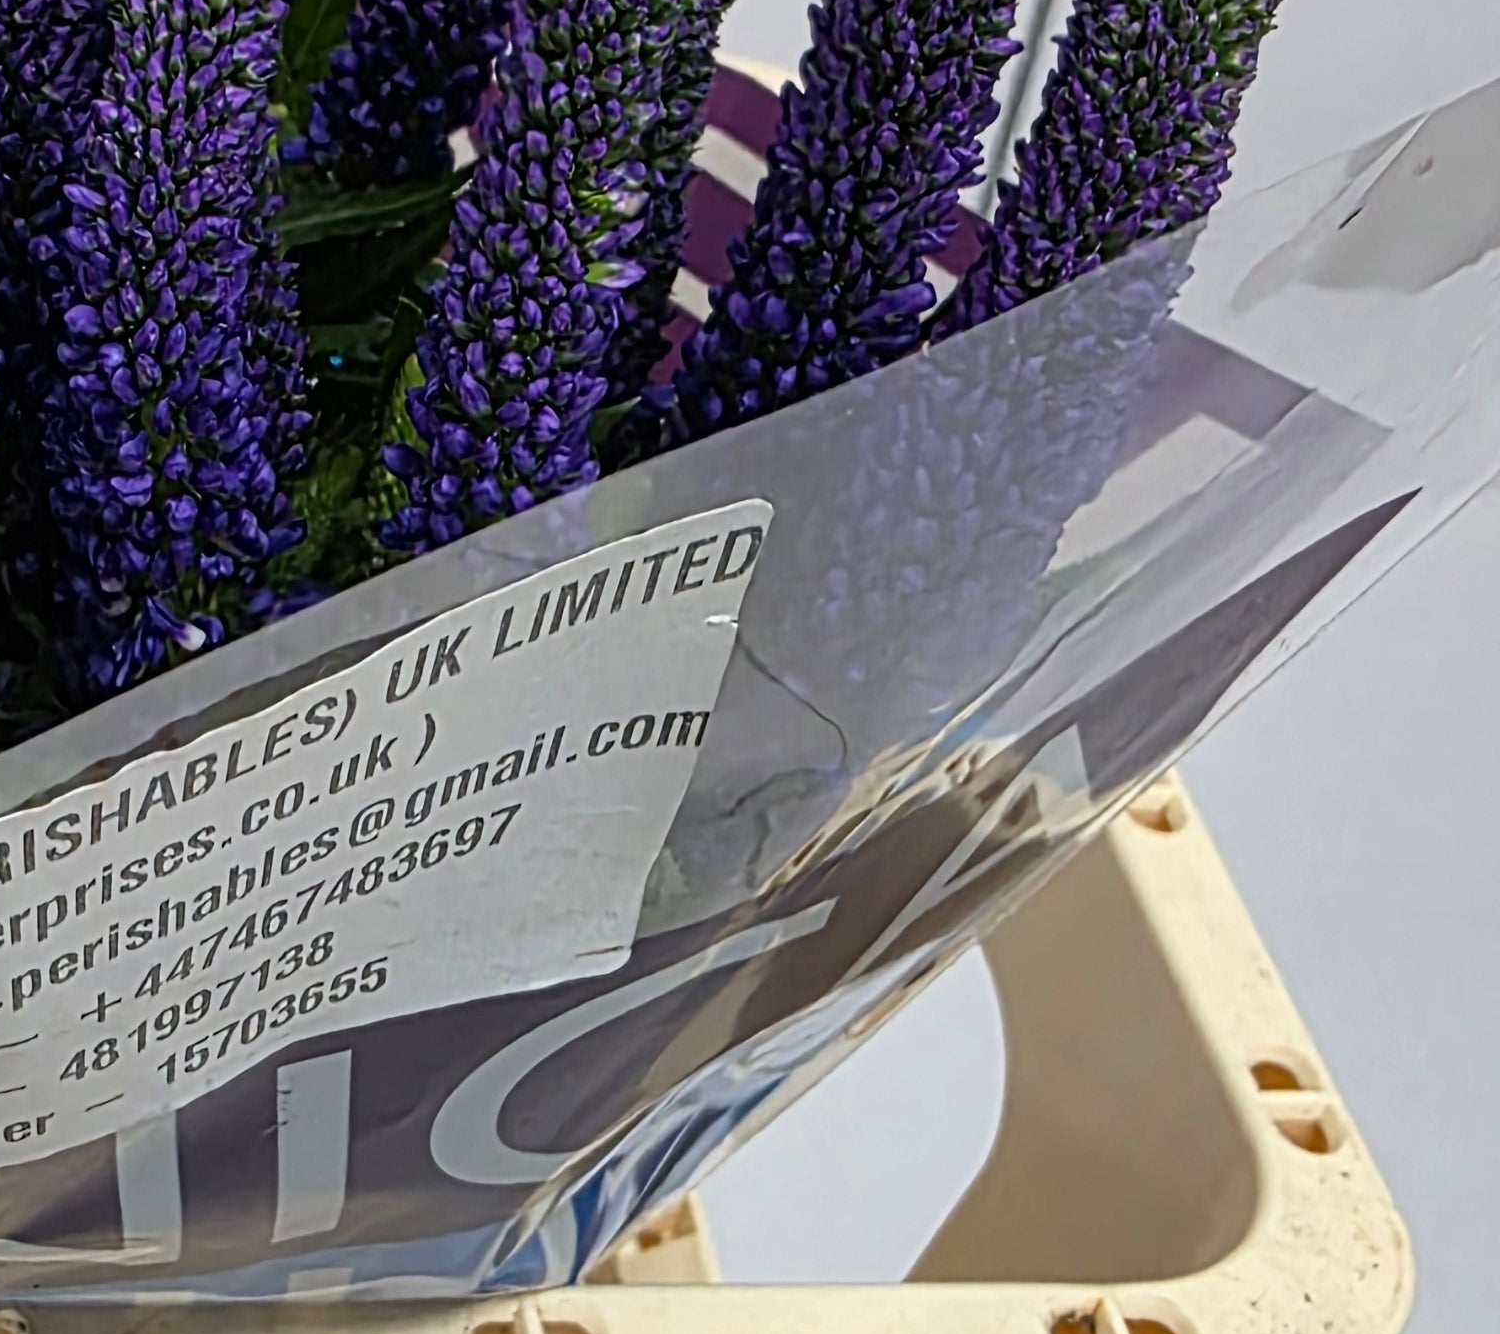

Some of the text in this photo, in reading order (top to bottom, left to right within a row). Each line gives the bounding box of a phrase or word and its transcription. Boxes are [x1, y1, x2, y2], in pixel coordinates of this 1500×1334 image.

[385, 626, 472, 704] UK
[492, 525, 764, 659] LIMITED
[80, 803, 523, 1025] +447467483697
[59, 931, 336, 1084] 481997138
[157, 956, 390, 1086] 15703655
